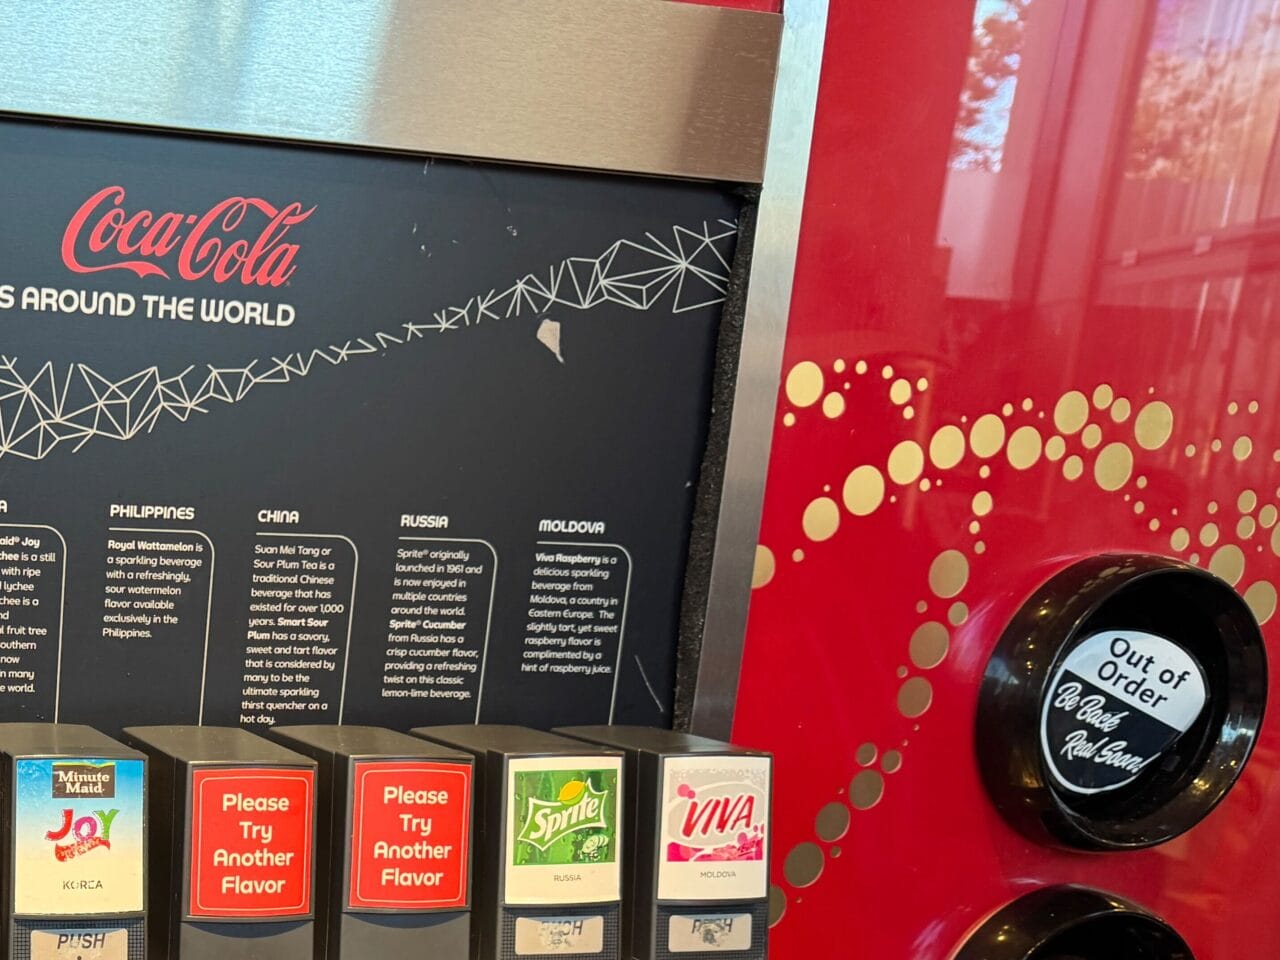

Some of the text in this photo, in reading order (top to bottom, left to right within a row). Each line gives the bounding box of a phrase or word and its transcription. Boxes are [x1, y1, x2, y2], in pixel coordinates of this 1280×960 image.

[61, 185, 317, 287] Coca-Cola
[21, 286, 135, 317] AROUND
[142, 295, 194, 320] THE
[200, 298, 296, 327] WORLD
[109, 504, 195, 520] PHILIPPINES
[257, 509, 300, 523] CHINA
[400, 513, 449, 529] RUSSIA
[538, 518, 606, 534] MOLDOVA
[107, 539, 135, 551] Royal
[195, 542, 203, 552] is
[21, 551, 28, 561] is
[30, 553, 37, 561] a
[39, 552, 55, 562] still
[115, 555, 158, 567] sparkling
[159, 555, 202, 568] beverage
[0, 566, 20, 575] with
[22, 567, 41, 578] ripe
[105, 569, 125, 578] with
[395, 562, 483, 574] launched in 1961 and
[252, 573, 334, 584] traditional Chinese
[3, 580, 34, 592] lychee
[105, 585, 181, 595] sour watermelon
[531, 580, 593, 592] beverage from
[104, 598, 174, 609] flavor available
[249, 602, 282, 612] existed
[283, 602, 296, 612] for
[297, 604, 318, 612] over
[103, 613, 178, 625] exclusively in the
[102, 627, 152, 639] Philippines.
[524, 636, 601, 647] raspberry flavor is
[1110, 638, 1191, 689] Out of
[1098, 660, 1168, 708] Order
[1054, 682, 1129, 732] Be Back
[1060, 730, 1109, 760] Real
[58, 771, 110, 782] Minute
[66, 782, 103, 794] Maid
[222, 793, 290, 812] Please
[383, 786, 449, 805] Please
[529, 792, 599, 842] Sprite
[682, 795, 755, 838] VIVA
[399, 814, 432, 836] Try
[239, 821, 273, 844] Try
[373, 841, 452, 859] Another
[213, 849, 294, 867] Another
[381, 868, 444, 887] Flavor
[554, 874, 582, 882] RUSSIA
[700, 871, 736, 879] MOLDOVA
[221, 876, 286, 894] Flavor
